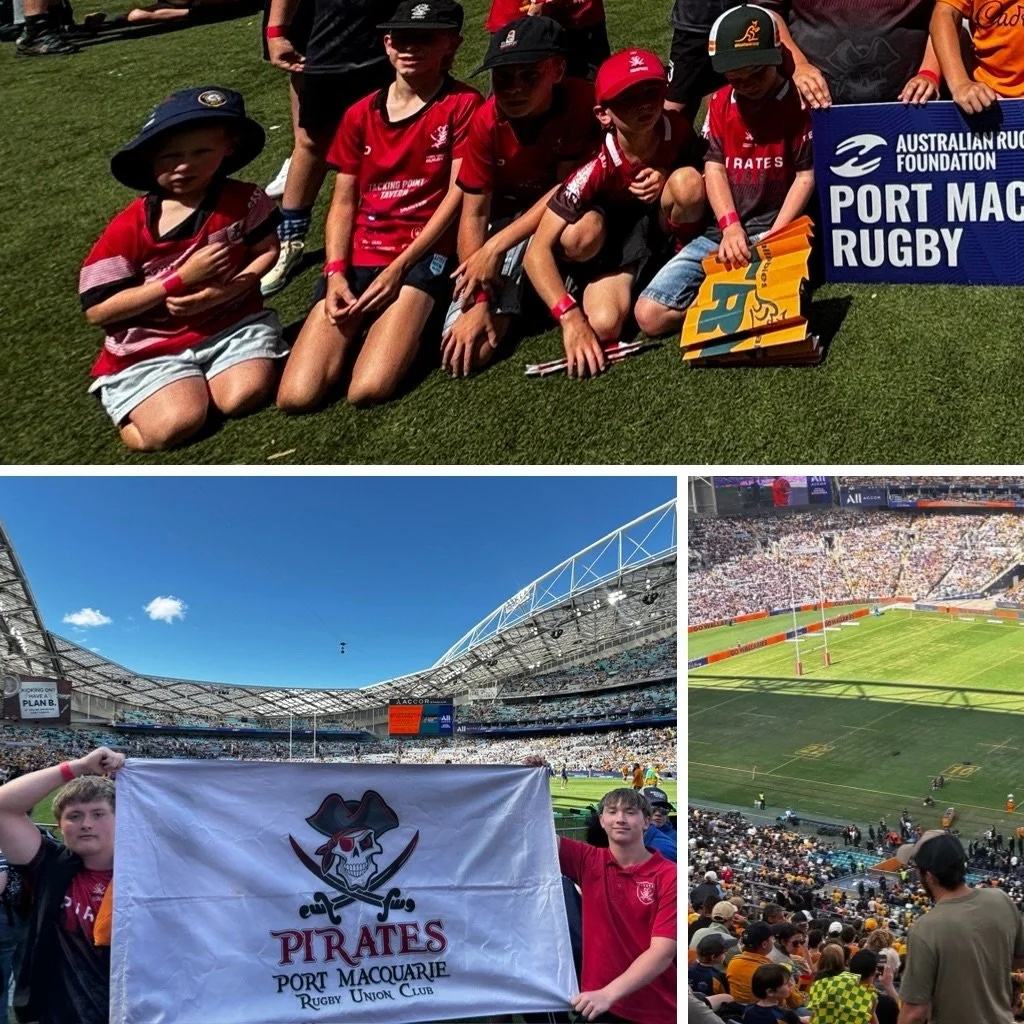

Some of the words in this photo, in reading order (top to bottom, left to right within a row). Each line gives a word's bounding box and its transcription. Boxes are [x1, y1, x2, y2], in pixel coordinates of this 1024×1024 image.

[896, 131, 993, 154] AUSTRALIAN
[725, 156, 784, 170] IRATES
[897, 151, 997, 173] FOUNDATION
[380, 189, 409, 200] TAVERN
[829, 183, 933, 224] PORT
[832, 228, 964, 268] RUGBY
[23, 699, 46, 707] PLAN
[48, 699, 57, 707] B.
[270, 920, 449, 967] PIRATES
[272, 971, 328, 993] PORT
[337, 961, 451, 988] MACQUARIE
